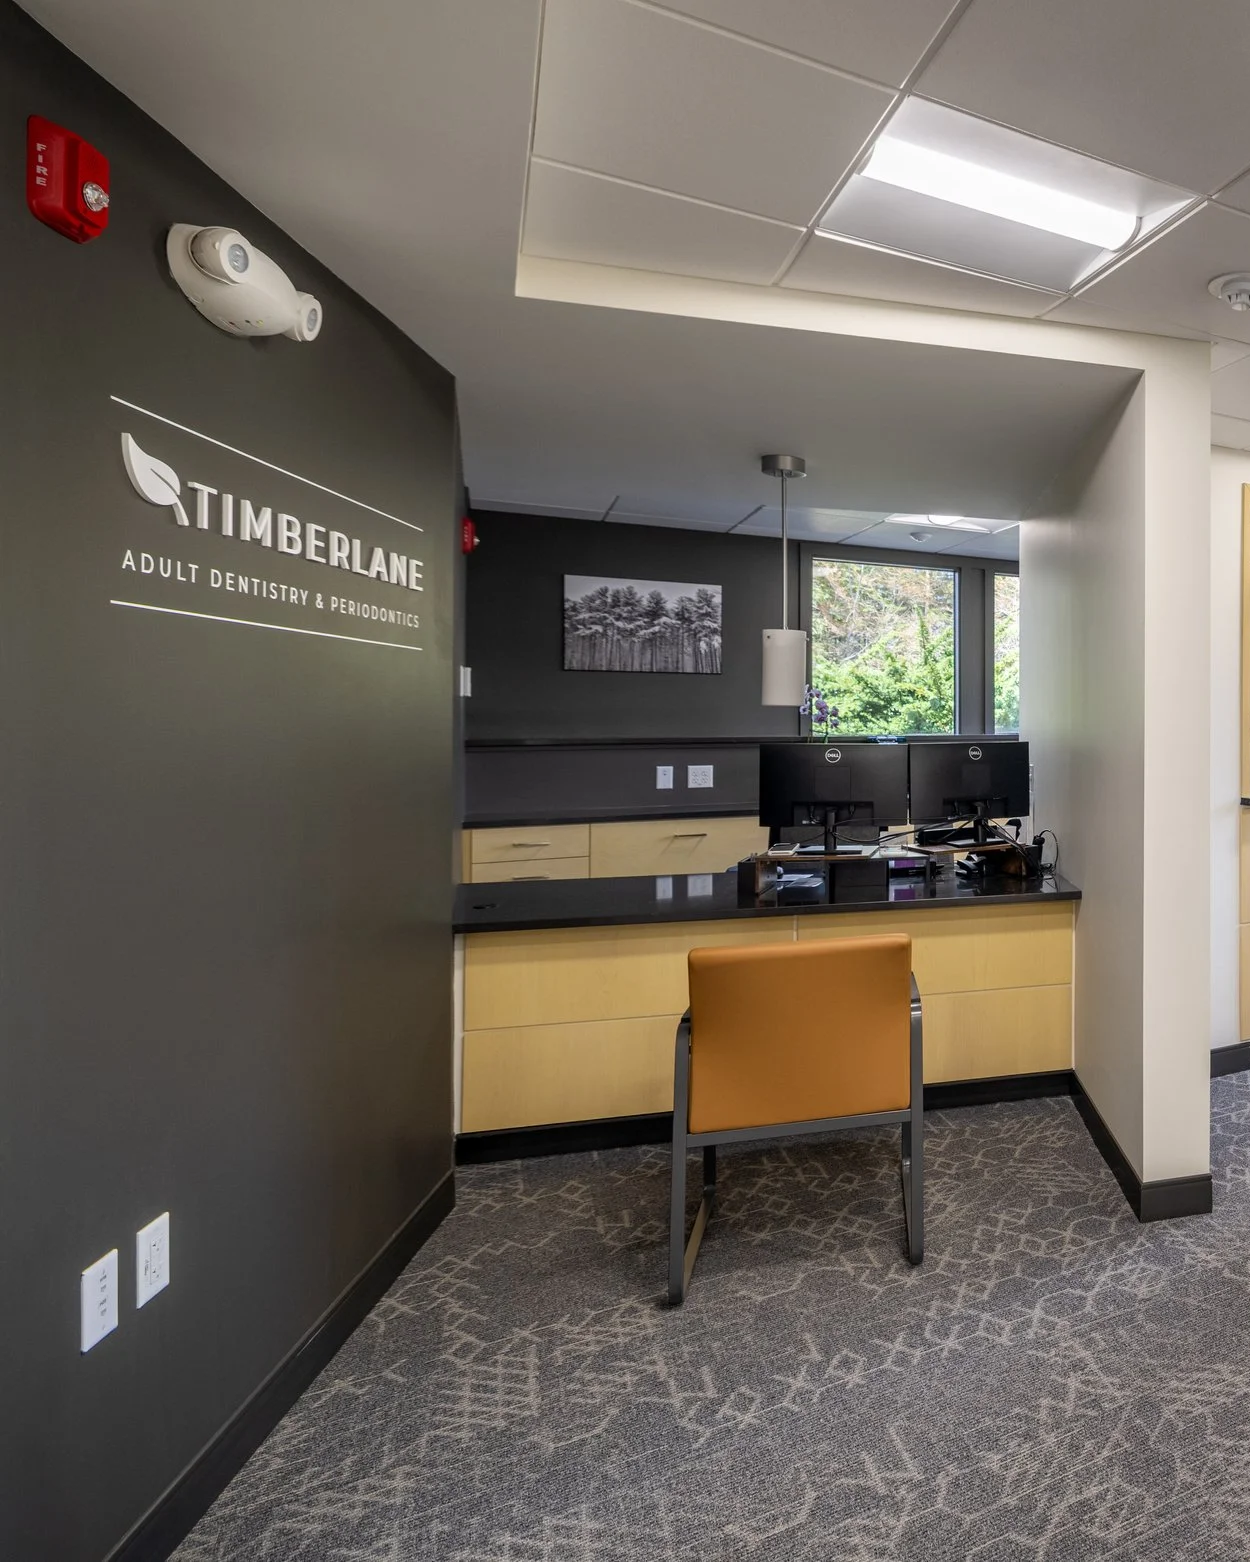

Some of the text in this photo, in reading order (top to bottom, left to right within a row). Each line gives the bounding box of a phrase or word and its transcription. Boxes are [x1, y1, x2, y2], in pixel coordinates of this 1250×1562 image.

[36, 142, 48, 187] FIRE
[187, 481, 424, 592] TIMBERLANE
[122, 549, 420, 629] ADULT DENTISTRY & PERIODONTICS
